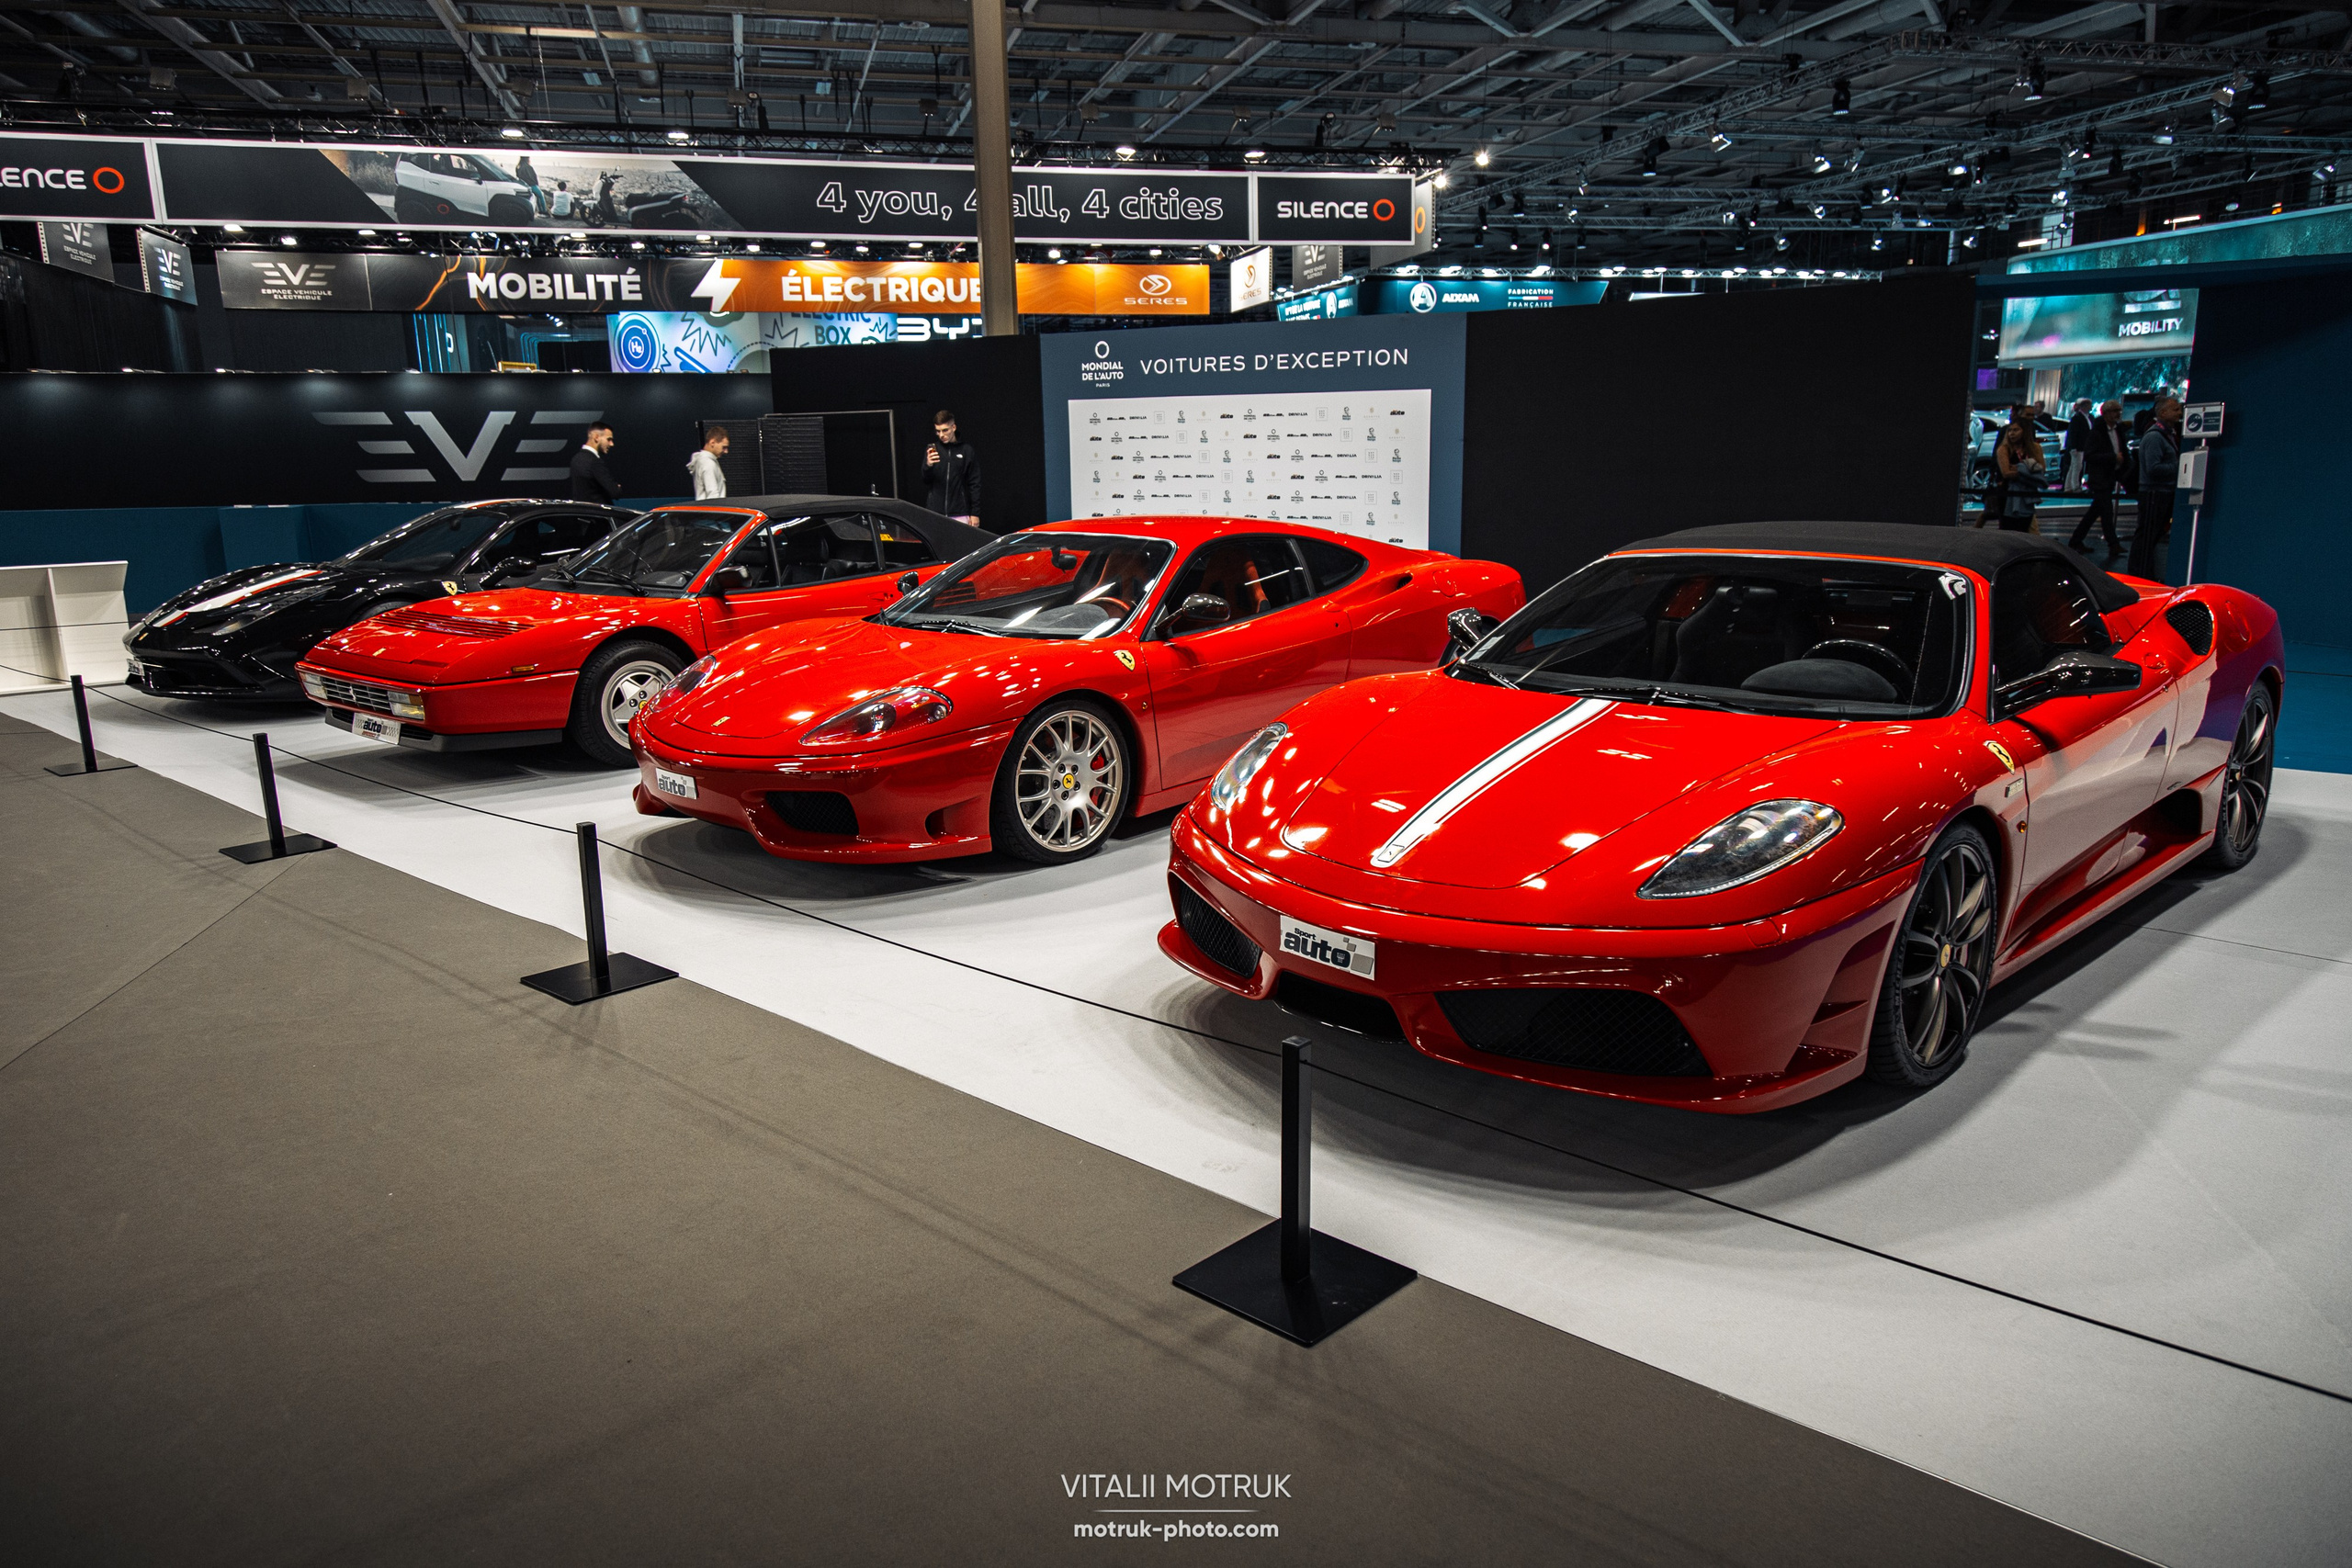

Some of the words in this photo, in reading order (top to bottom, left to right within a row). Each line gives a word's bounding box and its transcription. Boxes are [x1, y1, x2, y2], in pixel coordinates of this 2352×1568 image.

[0, 166, 87, 189] ENCE
[817, 182, 847, 213] 4
[854, 190, 953, 223] you,
[1081, 188, 1109, 219] 4
[1119, 187, 1224, 220] cities
[1277, 201, 1369, 219] SILENCE
[467, 266, 643, 300] MOBILITÉ
[1442, 293, 1480, 303] AIXAM
[815, 325, 851, 345] BOX
[2118, 318, 2183, 337] MOBILITY
[1081, 361, 1124, 371] MONDIAL
[1140, 355, 1246, 375] VOITURES
[1255, 348, 1408, 370] D'EXCEPTION
[1082, 373, 1093, 381] DE
[1094, 371, 1124, 380] L'AUTO
[363, 720, 382, 733] auto
[659, 778, 685, 795] auto
[1295, 928, 1317, 941] Sport
[1283, 932, 1351, 968] auto
